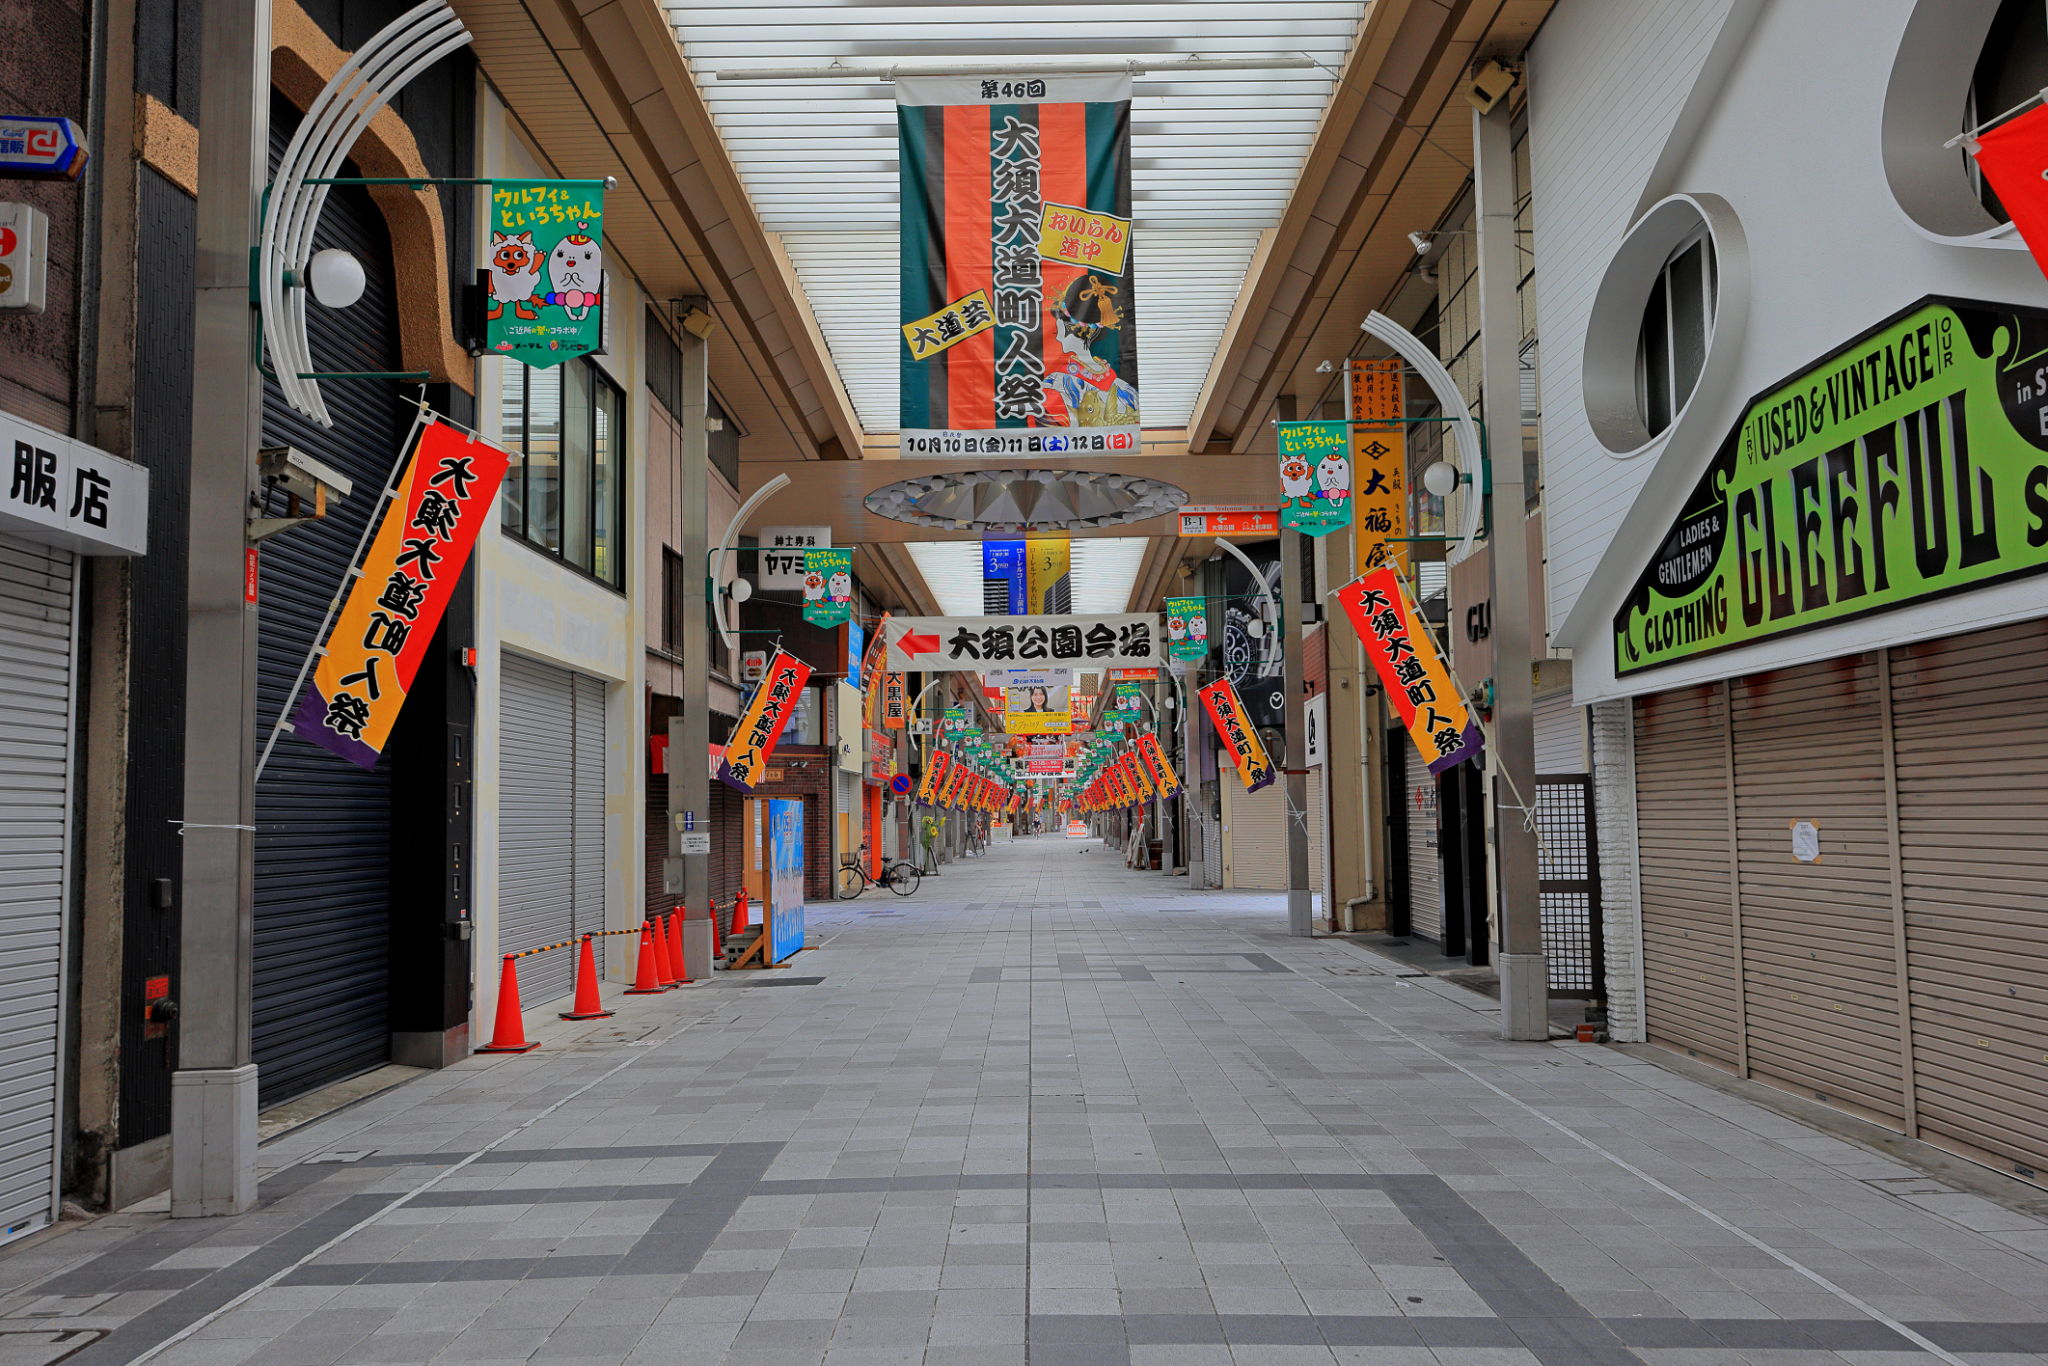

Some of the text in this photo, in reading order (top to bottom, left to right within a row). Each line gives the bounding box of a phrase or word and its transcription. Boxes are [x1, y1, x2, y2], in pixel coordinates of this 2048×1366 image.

[981, 79, 1046, 99] 第46回
[501, 201, 601, 227] といろちゃん
[1048, 211, 1123, 243] おいらん
[990, 116, 1046, 419] 大須大道町人祭
[1059, 235, 1102, 262] 道中
[912, 299, 992, 354] 大道芸
[1940, 316, 1954, 368] OUR
[2016, 382, 2032, 404] in
[1285, 434, 1346, 451] といろちゃん
[1744, 425, 1754, 465] TRY
[10, 439, 111, 529] 服店
[1183, 516, 1203, 526] B-1
[1363, 468, 1391, 568] 大福屋
[1734, 388, 2001, 628] GLEEFUL
[1680, 515, 1720, 548] LADIES &
[1658, 544, 1712, 584] GENTLEMEN
[1644, 574, 1728, 654] CLOTHING
[948, 622, 1152, 660] 大須公園会場
[1359, 589, 1464, 756] 大須大道町人祭
[887, 672, 902, 718] 大黒屋
[1210, 690, 1267, 785] 大須大道町人祭
